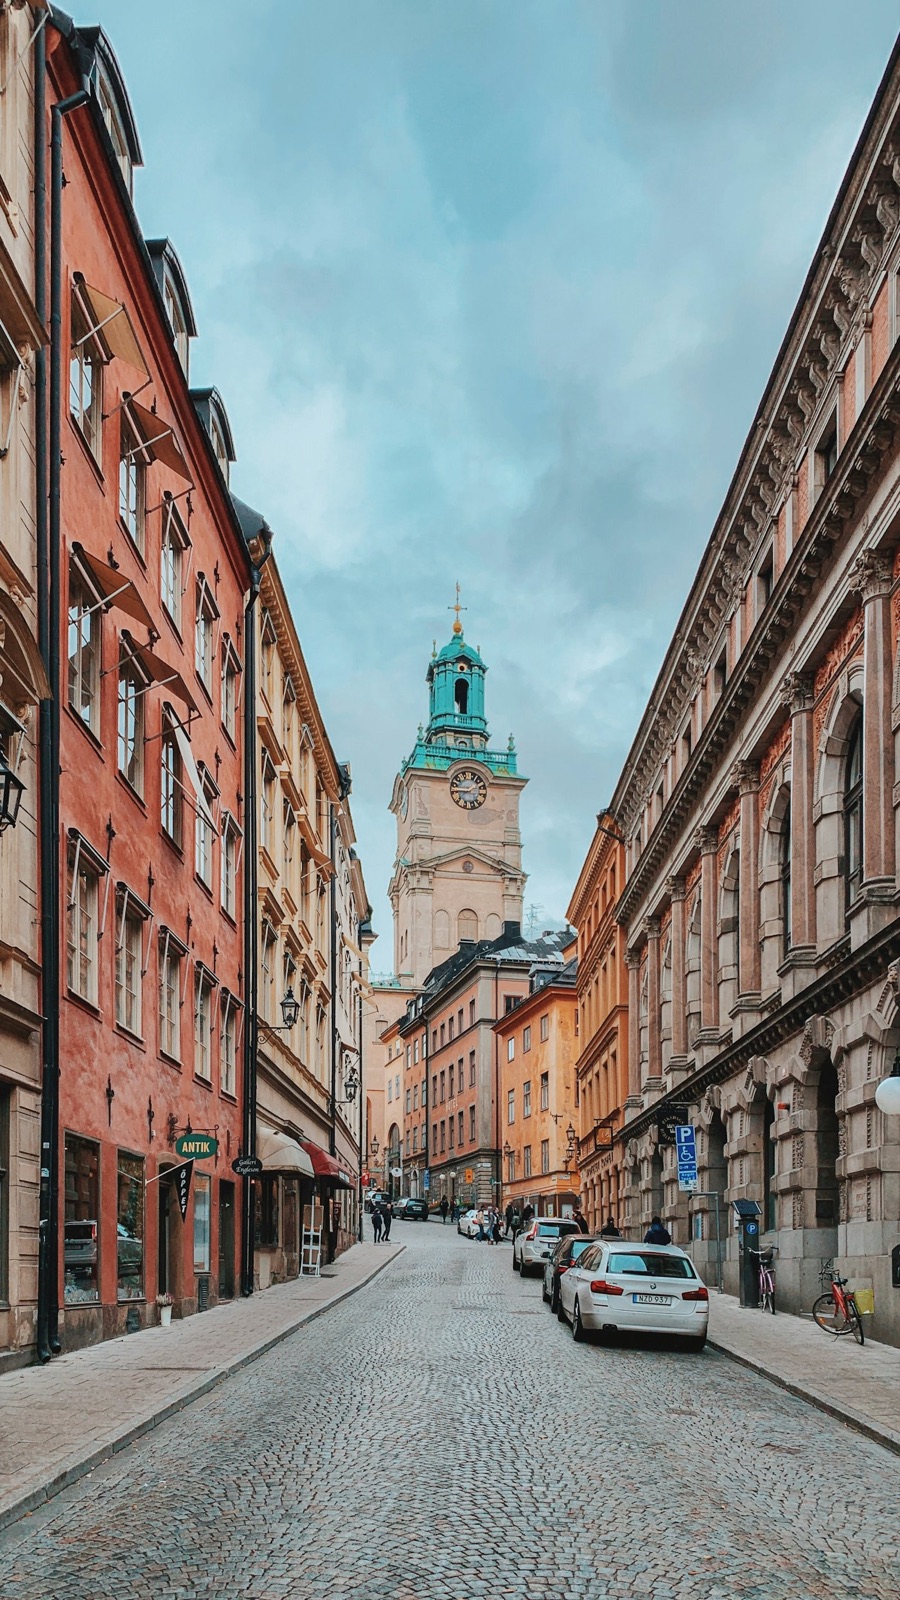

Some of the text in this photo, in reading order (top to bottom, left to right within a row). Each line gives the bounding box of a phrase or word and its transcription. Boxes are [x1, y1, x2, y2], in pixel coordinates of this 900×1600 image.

[681, 1127, 692, 1143] P
[181, 1141, 210, 1153] ANTIK
[749, 1224, 756, 1233] P
[654, 1296, 669, 1304] 937
